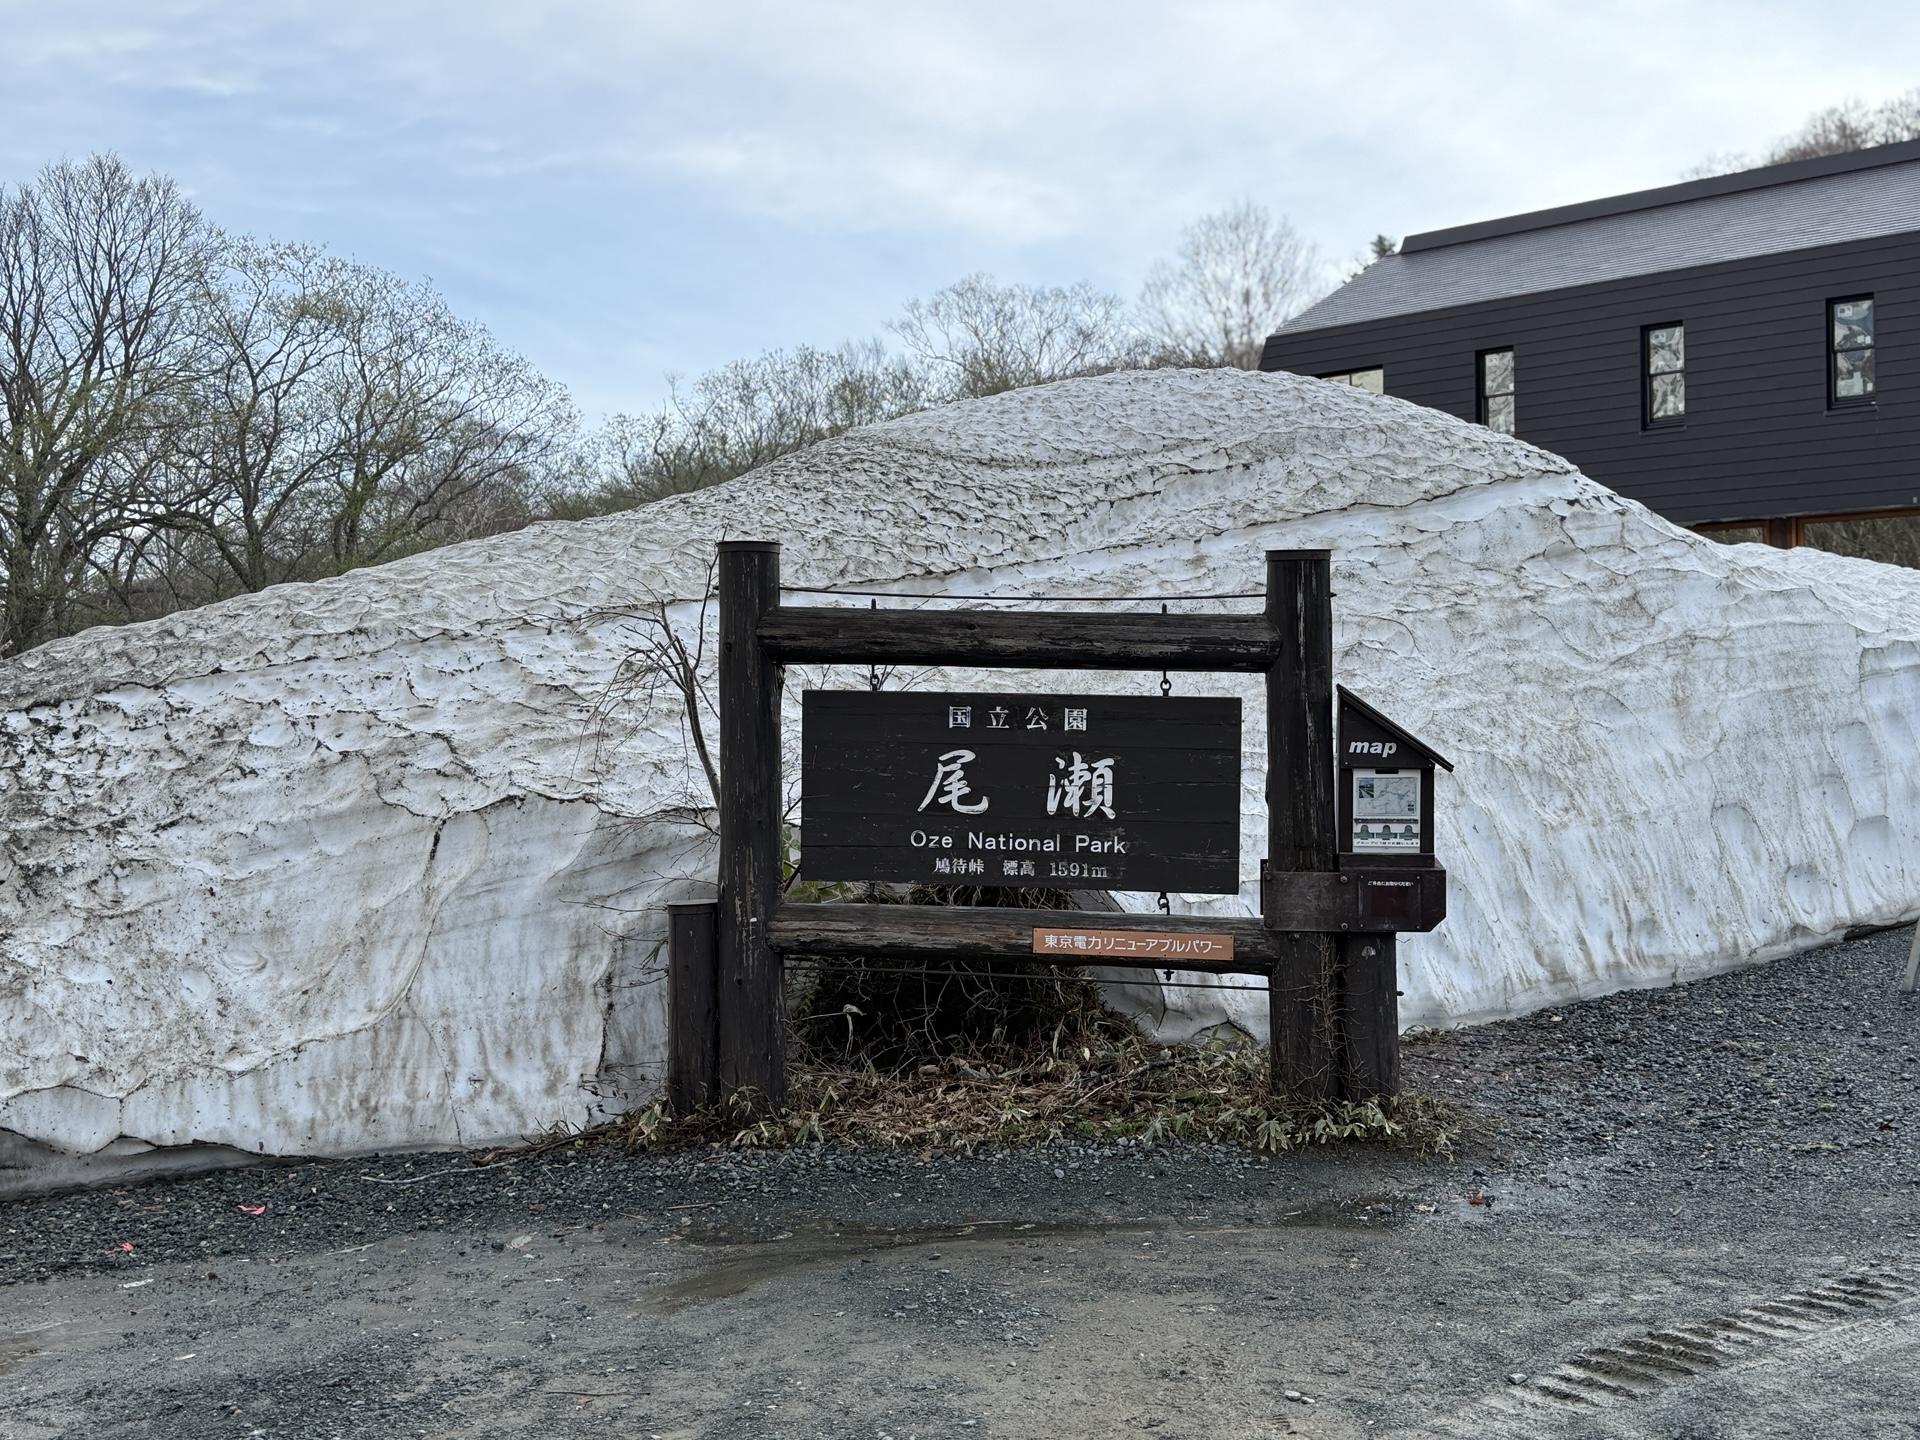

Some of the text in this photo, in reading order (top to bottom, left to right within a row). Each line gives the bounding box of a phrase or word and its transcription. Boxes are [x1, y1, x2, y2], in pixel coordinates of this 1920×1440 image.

[948, 706, 1087, 732] 国立公園
[1349, 740, 1397, 758] map
[917, 749, 1116, 820] 尾瀬
[910, 829, 1127, 854] Oze National Park
[933, 858, 1108, 878] 鳩待峠 標高 1591m
[1044, 934, 1222, 954] 東京電力リニューアブルパワー
